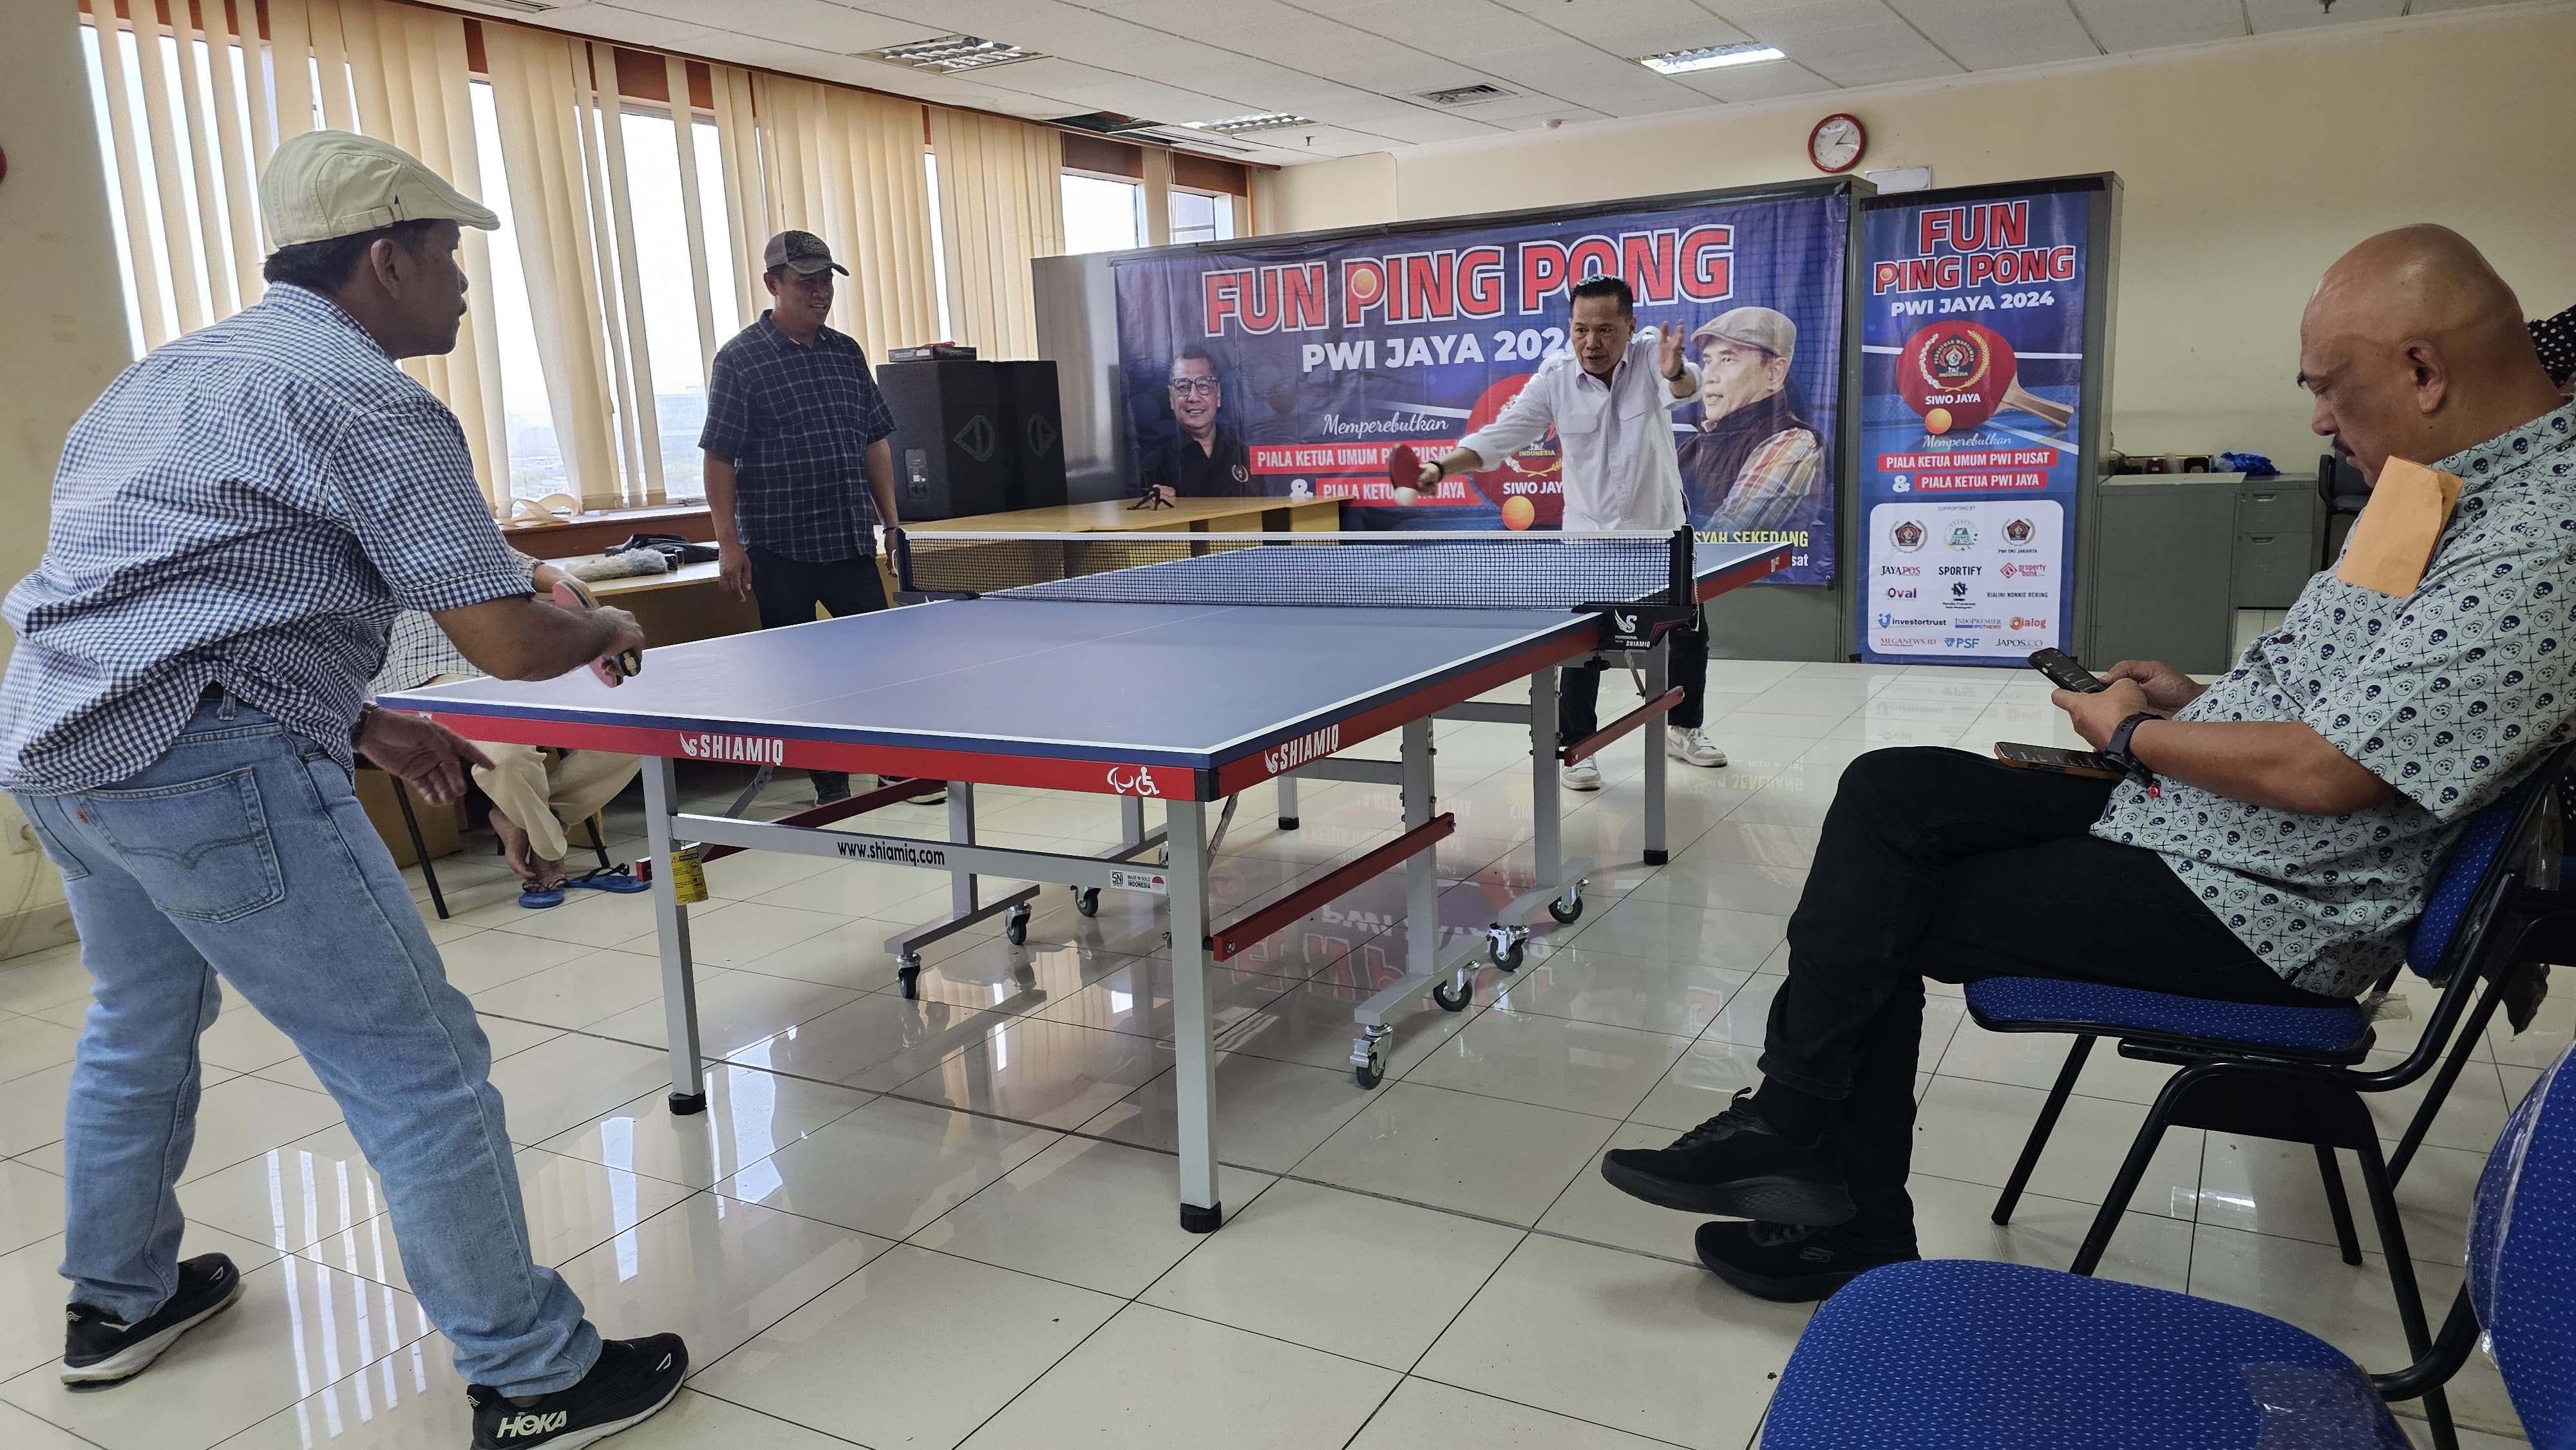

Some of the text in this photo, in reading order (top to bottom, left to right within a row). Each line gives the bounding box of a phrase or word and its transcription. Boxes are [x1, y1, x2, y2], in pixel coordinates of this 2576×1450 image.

[1918, 200, 2029, 256] FUN
[1873, 246, 2076, 296] PING PONG
[1202, 224, 1734, 337] FUN PING PONG
[1891, 290, 2054, 316] PWI JAYA 2024
[1303, 327, 1572, 373] PWI JAYA 202
[1925, 393, 1980, 404] SIWO JAYA
[1323, 412, 1449, 438] Memperebutkan
[1922, 432, 2011, 449] Memperebutkan
[1258, 451, 1292, 467] PIALA
[1296, 449, 1334, 467] KETUA
[1338, 448, 1377, 466] UMUM
[1886, 451, 2050, 469] PIALA KETUA UMUM PWI PUSAT
[1290, 478, 1395, 500] & PIALA KETU
[1436, 482, 1466, 499] JAYA
[1503, 481, 1564, 495] SIWO JAY
[1892, 473, 2039, 493] & PIALA KETUA PWI JAYA
[1694, 531, 1808, 547] SYAH SEKEDANG
[1791, 554, 1808, 567] sat
[1938, 566, 1982, 576] SPORTIFY
[1888, 587, 1917, 598] Oval
[1625, 640, 1651, 648] SHIAMIQ
[1956, 638, 1980, 648] PSF
[1995, 639, 2043, 647] JAPOS.CO
[700, 735, 783, 766] SHIAMIQ
[1280, 723, 1340, 771] SHIAMIQ
[837, 841, 945, 867] www.shiamiq.com
[1128, 881, 1151, 889] INDONESIA
[497, 1410, 567, 1438] HOKA
